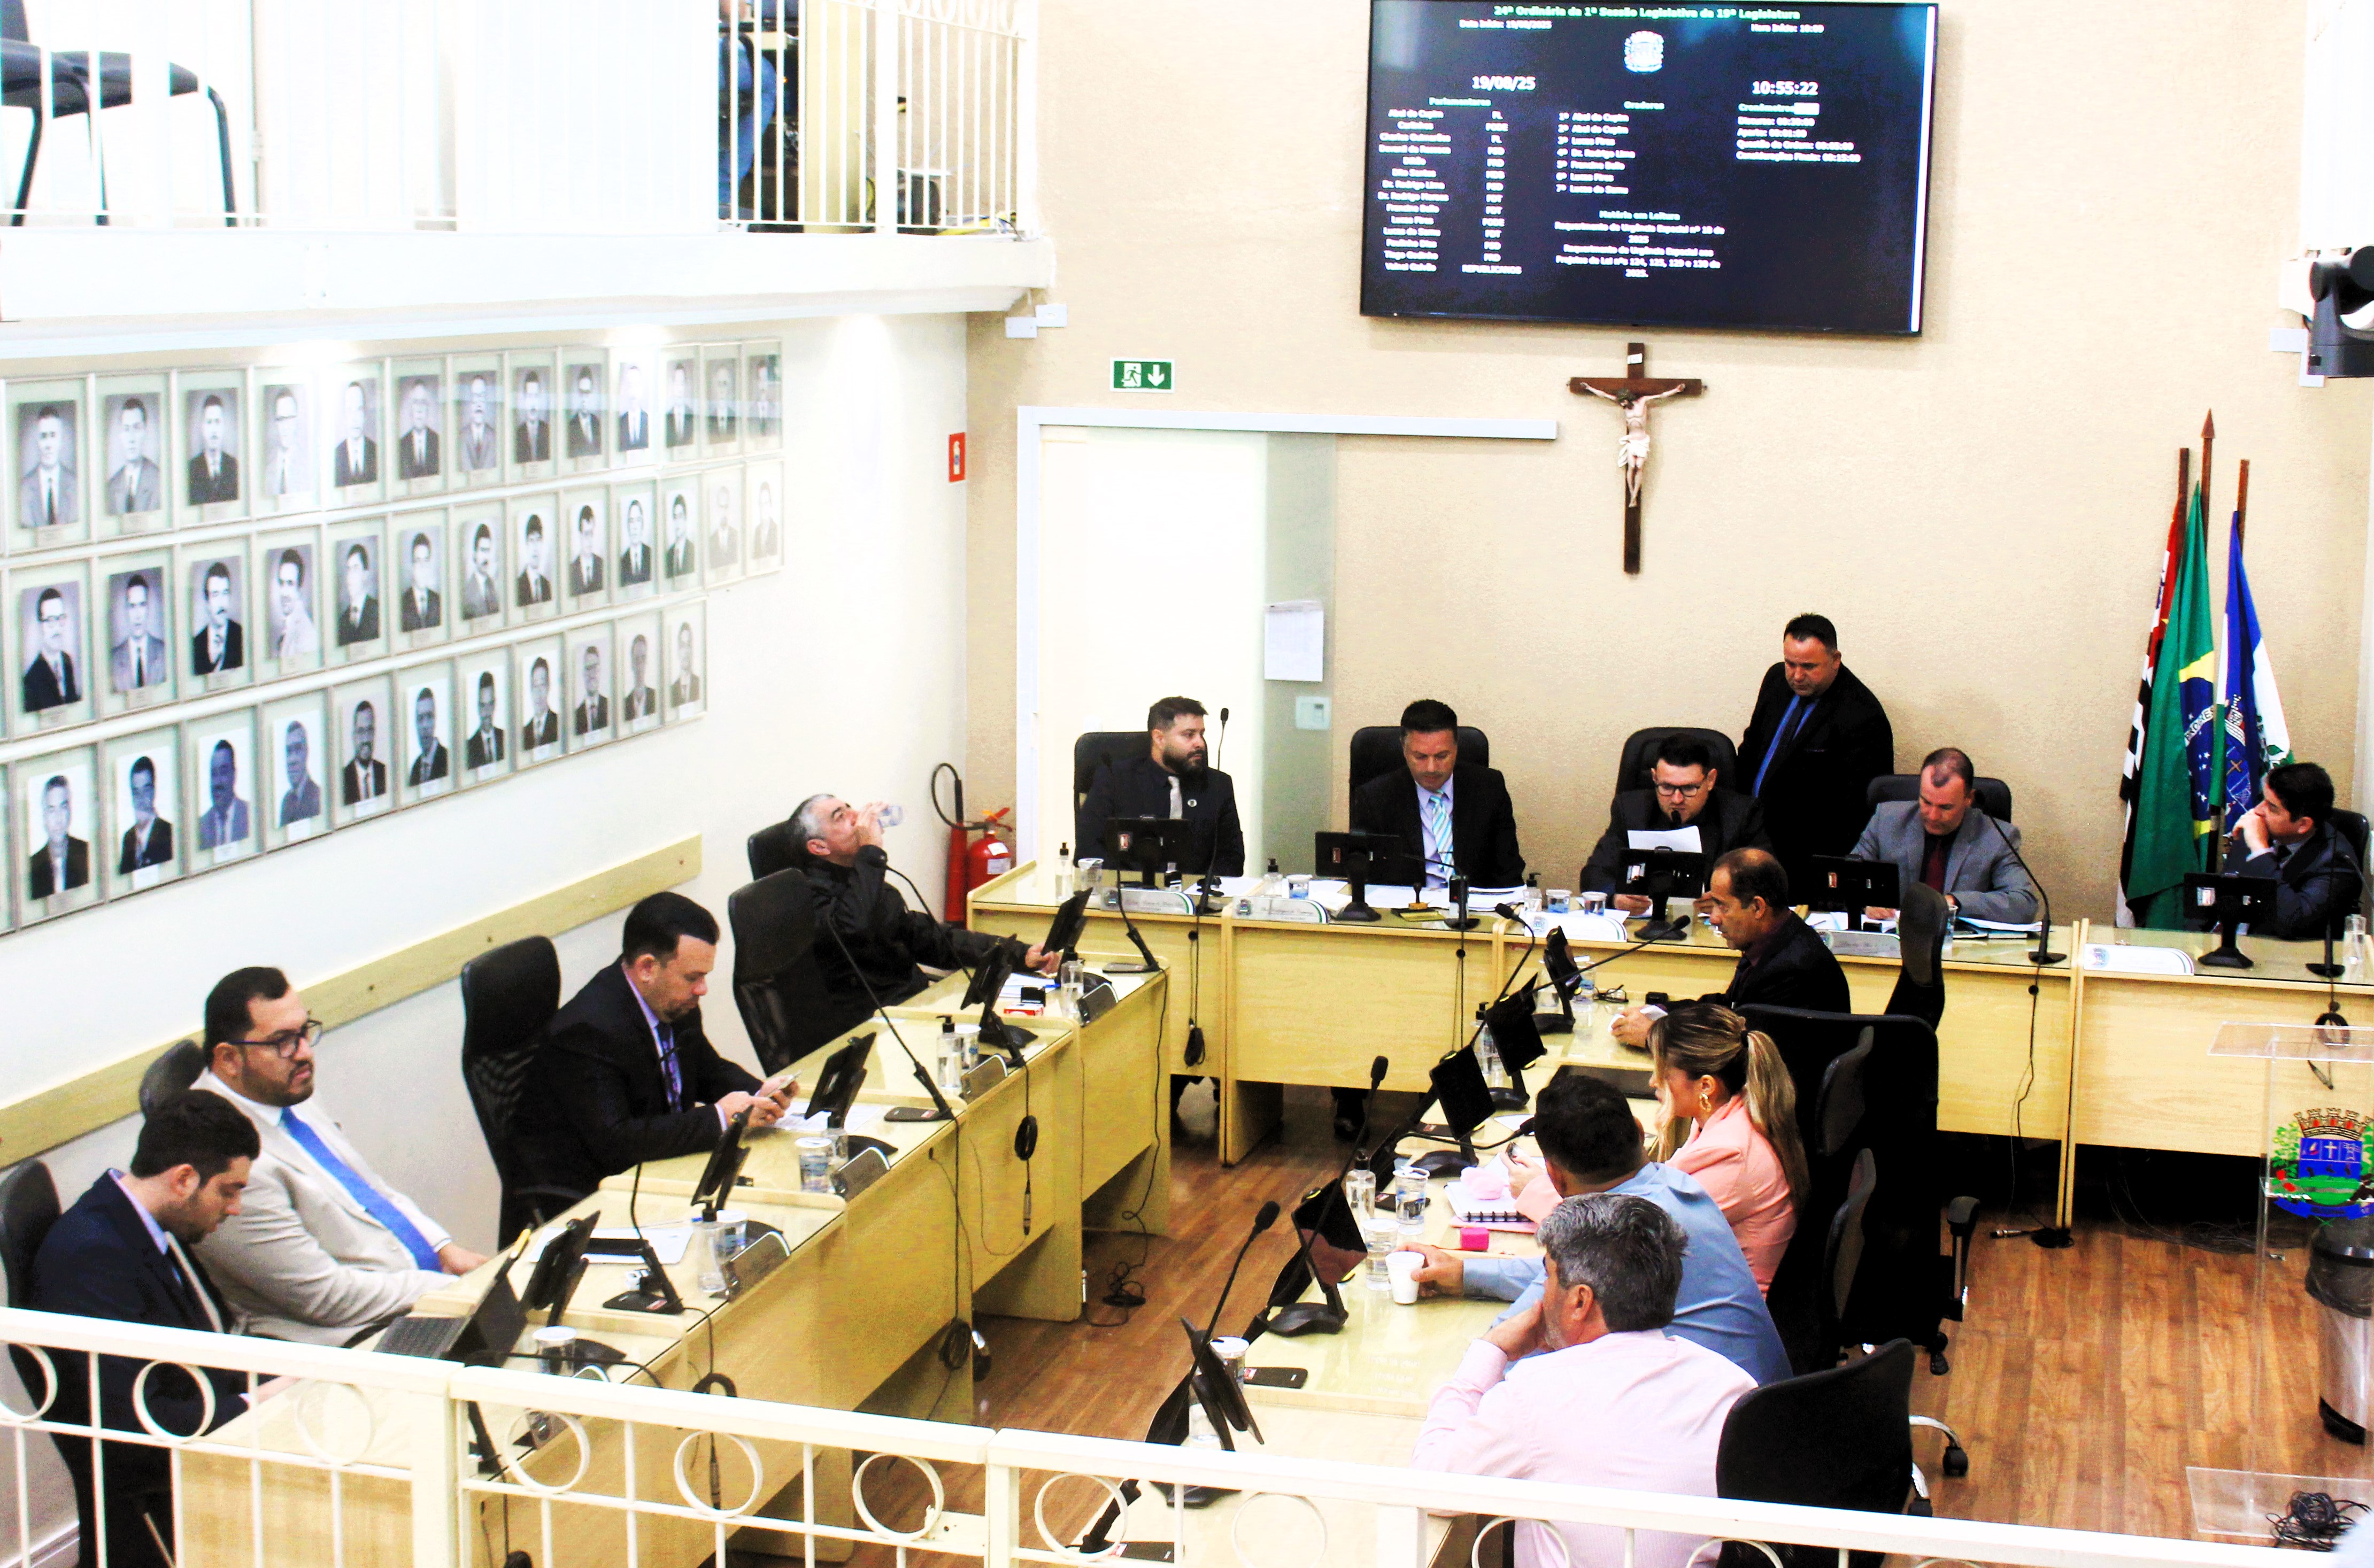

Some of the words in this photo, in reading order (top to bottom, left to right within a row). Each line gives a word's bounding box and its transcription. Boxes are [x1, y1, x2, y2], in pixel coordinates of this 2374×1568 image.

[1516, 6, 1566, 16] Ordinária
[1568, 7, 1582, 16] da
[1599, 7, 1637, 17] Sessão
[1640, 8, 1698, 19] Legislativa
[1700, 9, 1714, 18] da
[1739, 9, 1800, 20] Legislatura
[1472, 76, 1536, 91] 19/08/25
[1753, 81, 1818, 95] 10:55:22
